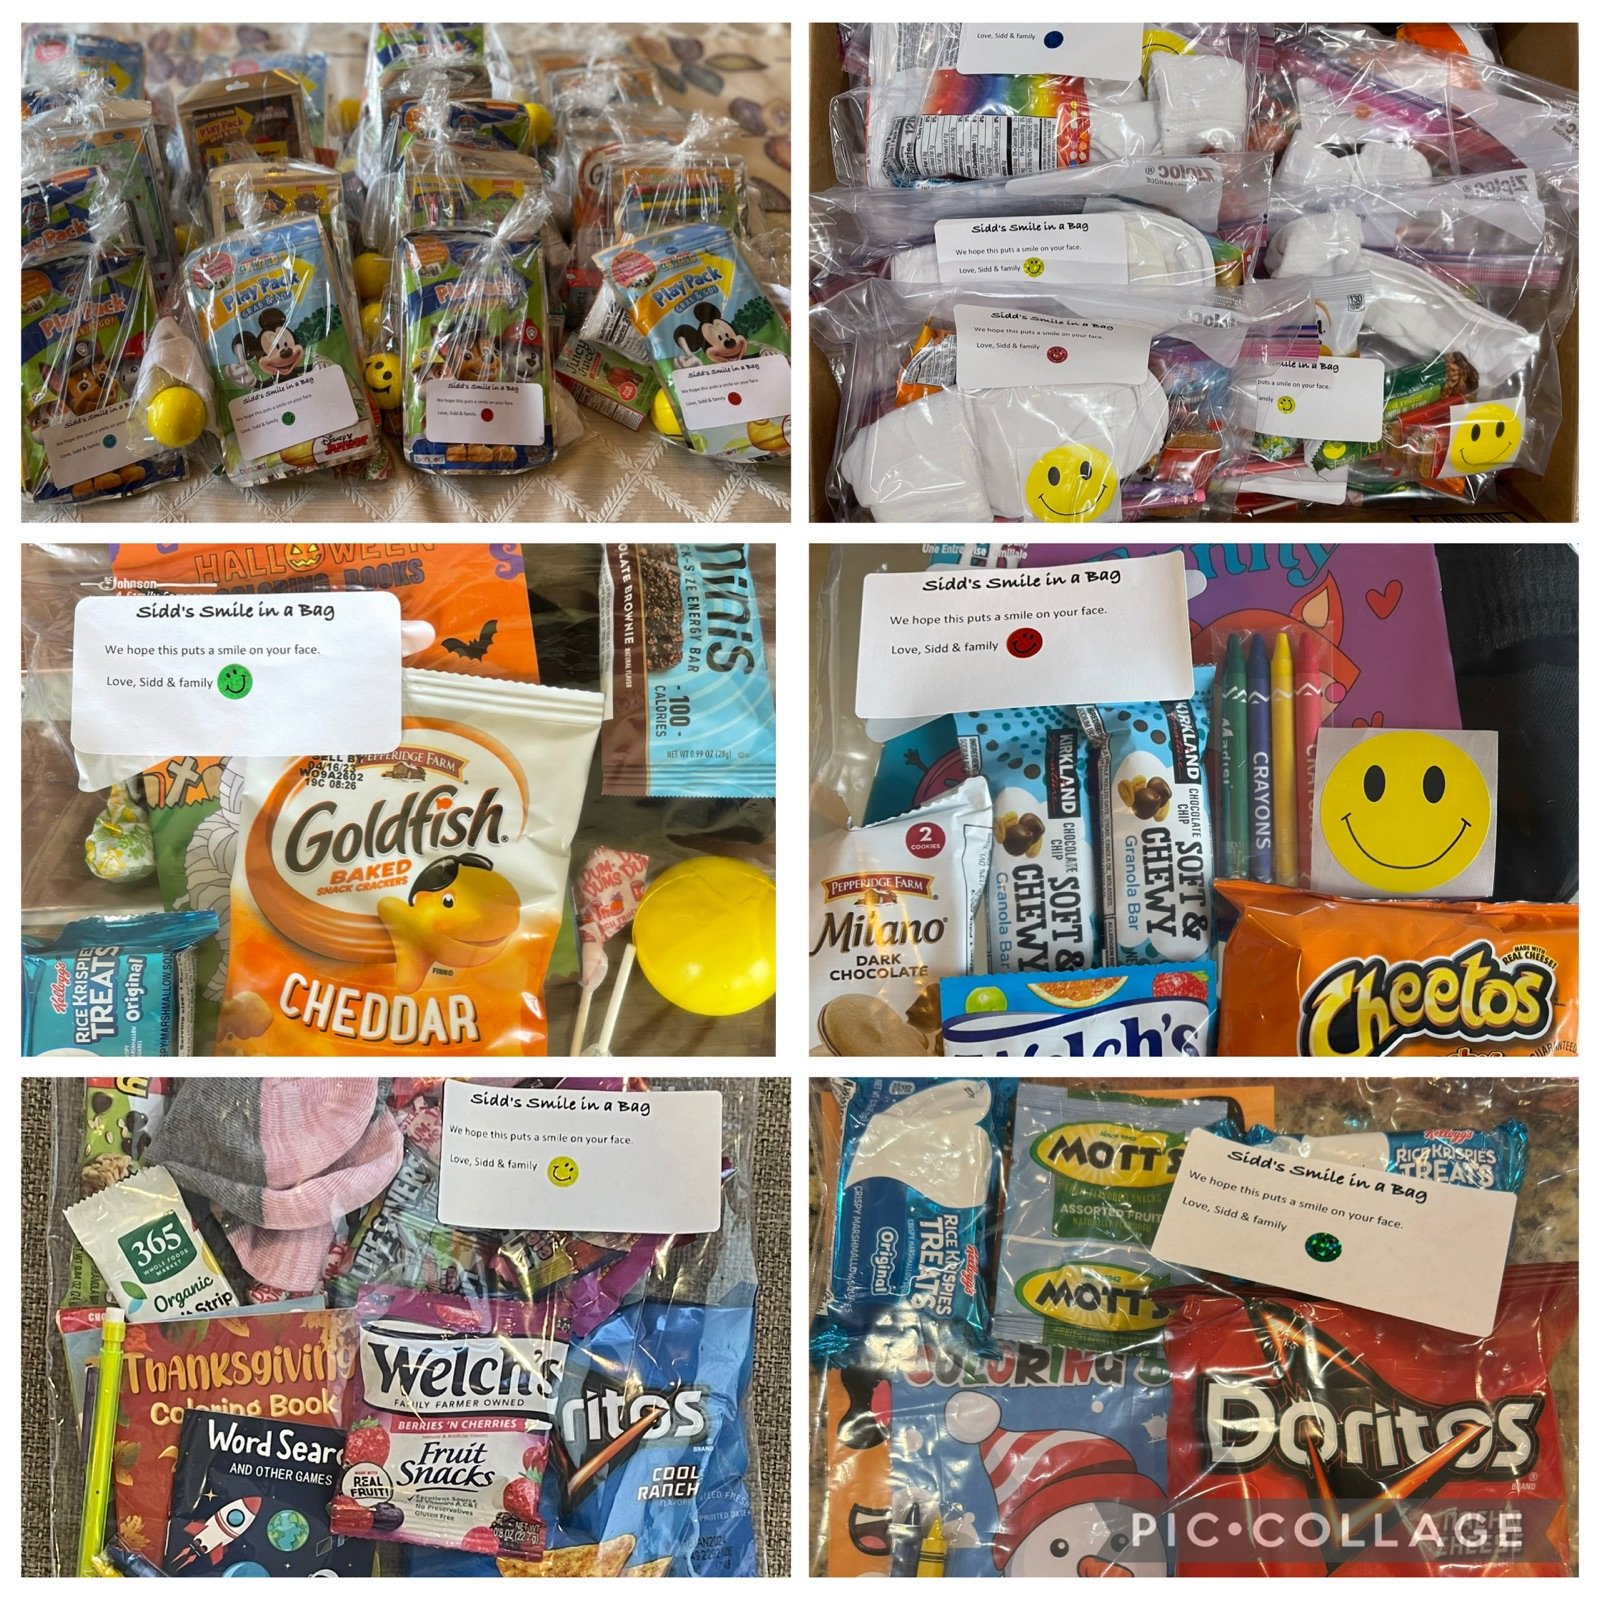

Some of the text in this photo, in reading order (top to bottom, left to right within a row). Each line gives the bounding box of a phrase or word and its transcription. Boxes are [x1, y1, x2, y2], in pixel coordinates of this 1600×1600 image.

[1016, 32, 1036, 41] family
[971, 221, 1089, 234] Sidd's Smile in a Bag
[222, 285, 258, 313] Play
[258, 271, 300, 296] Pack
[653, 280, 687, 308] Play
[684, 266, 723, 289] Pack
[344, 559, 425, 591] BOOKS
[922, 569, 1121, 592] Sidd's Smile in a Bag
[135, 600, 335, 622] Sidd's Smile in a Bag
[624, 585, 634, 644] BROWNIE
[889, 605, 1108, 626] We hope this puts a smile on your face.
[686, 596, 702, 673] ENERGY BAR
[104, 643, 320, 658] We hope this puts a smile on your face.
[891, 640, 999, 656] Love, Sidd & family
[106, 676, 214, 690] Love, Sidd & family
[654, 685, 667, 737] CALORIES
[670, 695, 689, 727] 100
[1176, 702, 1199, 779] KIRKLAND
[308, 761, 356, 774] 04/16/23
[426, 754, 455, 771] FARM
[305, 778, 357, 790] 19C 08:26
[1189, 789, 1201, 837] CHOCOLATE
[1253, 752, 1271, 849] CRAYONS
[1178, 804, 1189, 824] CHIP
[285, 785, 503, 873] Goldfish
[919, 827, 932, 841] 2
[330, 859, 412, 885] BAKED
[1125, 836, 1141, 931] Granola Bar
[1141, 827, 1176, 937] CHEWY
[316, 877, 408, 896] SNACK CRACKERS
[832, 876, 923, 895] PEPPERIDGE FARM
[1176, 842, 1207, 941] SOFT &
[809, 912, 945, 956] Milano
[856, 954, 901, 966] DARK
[1502, 950, 1557, 969] REAL CHEESE!
[830, 966, 928, 981] CHOCOLATE
[50, 962, 71, 1014] Kellogg's
[90, 946, 120, 1040] TREATS
[125, 958, 143, 1021] Original
[279, 972, 480, 1046] CHEDDAR
[1309, 950, 1543, 1056] Cheetos
[76, 1006, 90, 1044] RICE
[470, 1091, 651, 1117] Sidd's Smile in a Bag
[1424, 1128, 1473, 1141] Kellogg's
[1432, 1144, 1496, 1163] KRISPIES
[1227, 1151, 1428, 1205] Sidd's Smile in a Bag
[1061, 1203, 1162, 1222] ASSORTED FRUIT
[1189, 1169, 1207, 1183] We
[1209, 1176, 1238, 1192] hope
[1240, 1185, 1260, 1197] this
[1261, 1192, 1287, 1204] puts
[1298, 1201, 1329, 1214] smile
[1330, 1208, 1346, 1217] on
[1348, 1211, 1375, 1223] your
[1377, 1215, 1403, 1230] face.
[1182, 1196, 1288, 1232] Love, Sidd & family
[132, 1222, 182, 1267] 365
[156, 1261, 182, 1277] MARKET
[872, 1231, 894, 1293] Original
[910, 1220, 944, 1310] TREATS
[154, 1276, 214, 1313] Organic
[368, 1342, 559, 1399] Welch's
[436, 1399, 479, 1408] FARMER
[398, 1421, 443, 1430] BERRIES
[462, 1419, 517, 1429] CHERRIES
[1206, 1382, 1542, 1468] Doritos
[208, 1419, 272, 1457] Word
[418, 1441, 488, 1465] Fruit
[230, 1463, 332, 1486] AND OTHER GAMES
[353, 1476, 383, 1487] REAL
[396, 1461, 495, 1487] Snacks
[653, 1466, 699, 1481] COOL
[351, 1486, 389, 1497] FRUIT!
[638, 1483, 699, 1500] RANCH
